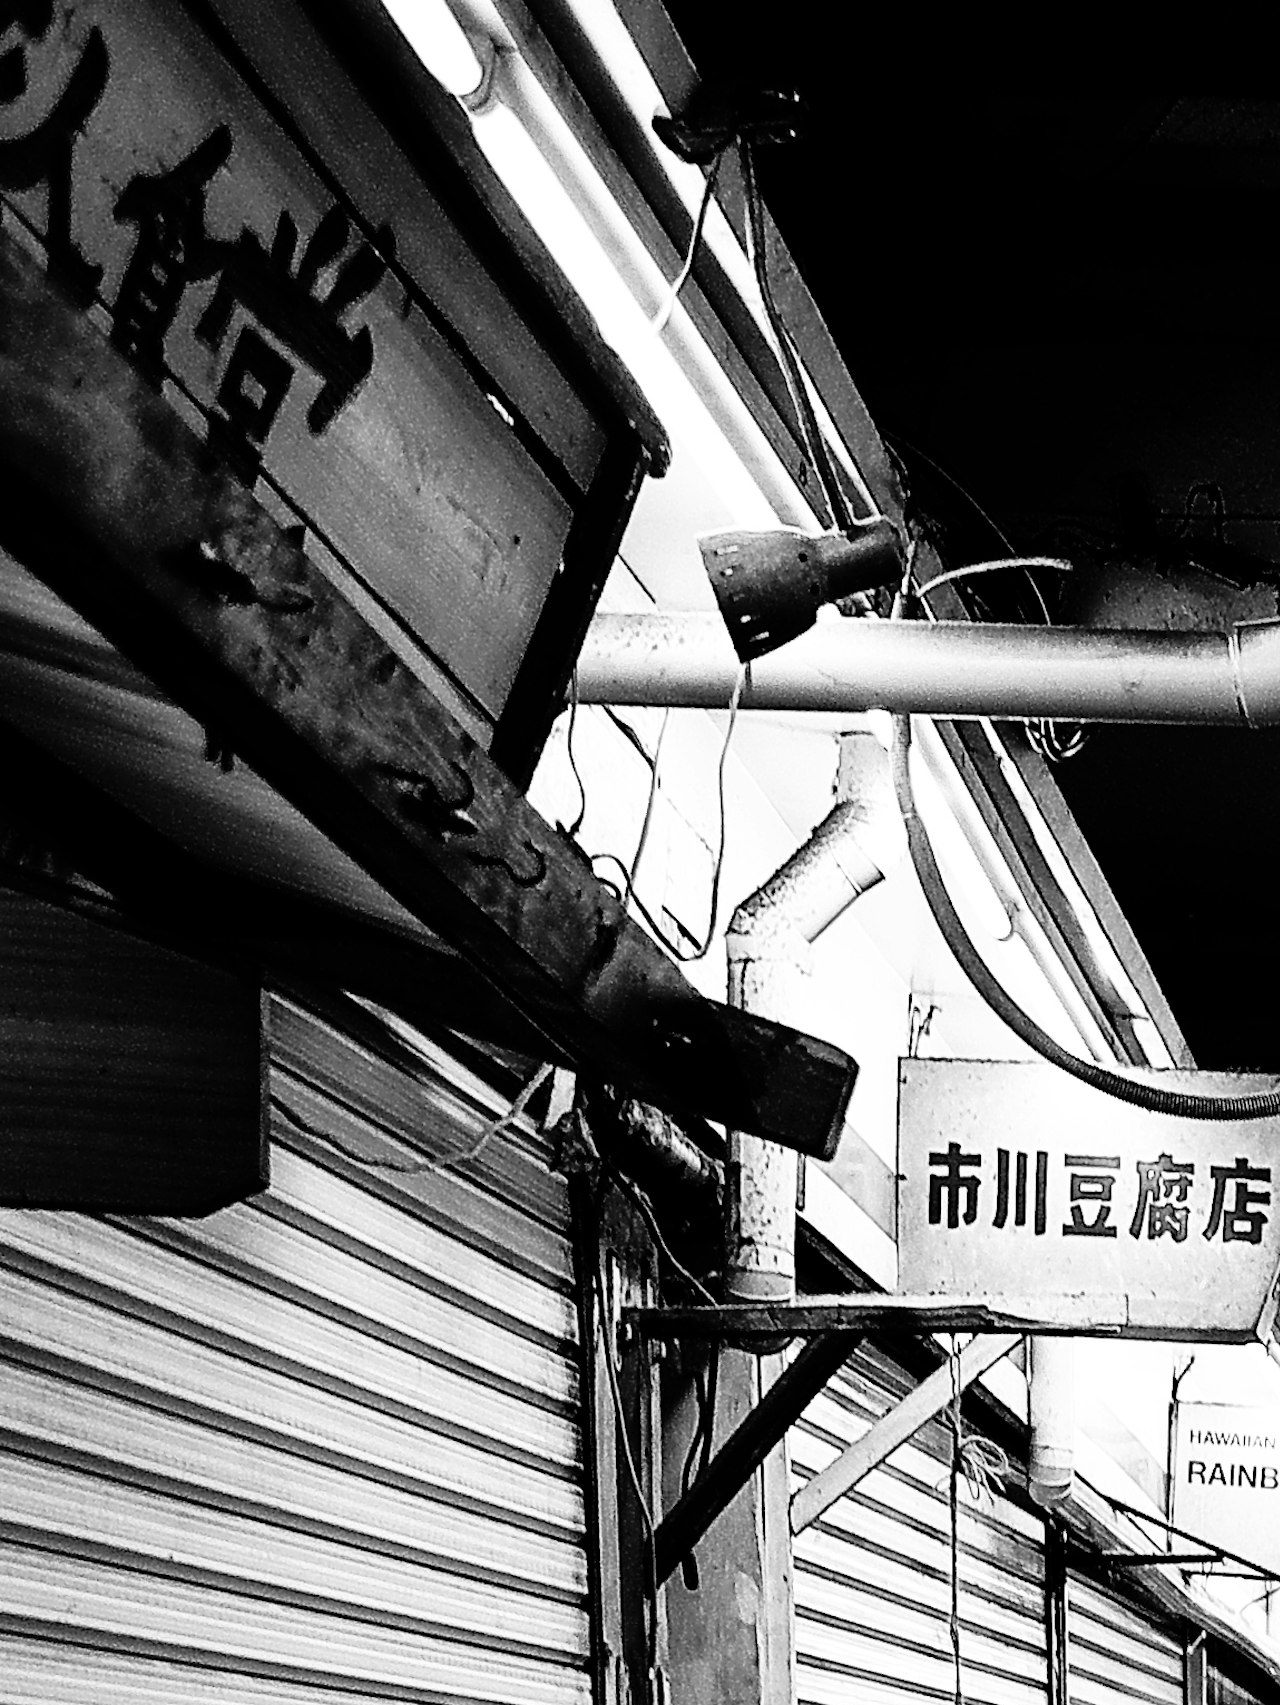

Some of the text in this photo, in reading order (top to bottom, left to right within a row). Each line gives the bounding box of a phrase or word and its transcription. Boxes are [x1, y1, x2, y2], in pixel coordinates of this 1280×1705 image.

[928, 1141, 1272, 1245] 市川豆腐店
[1190, 1429, 1276, 1450] HAWAIIAN
